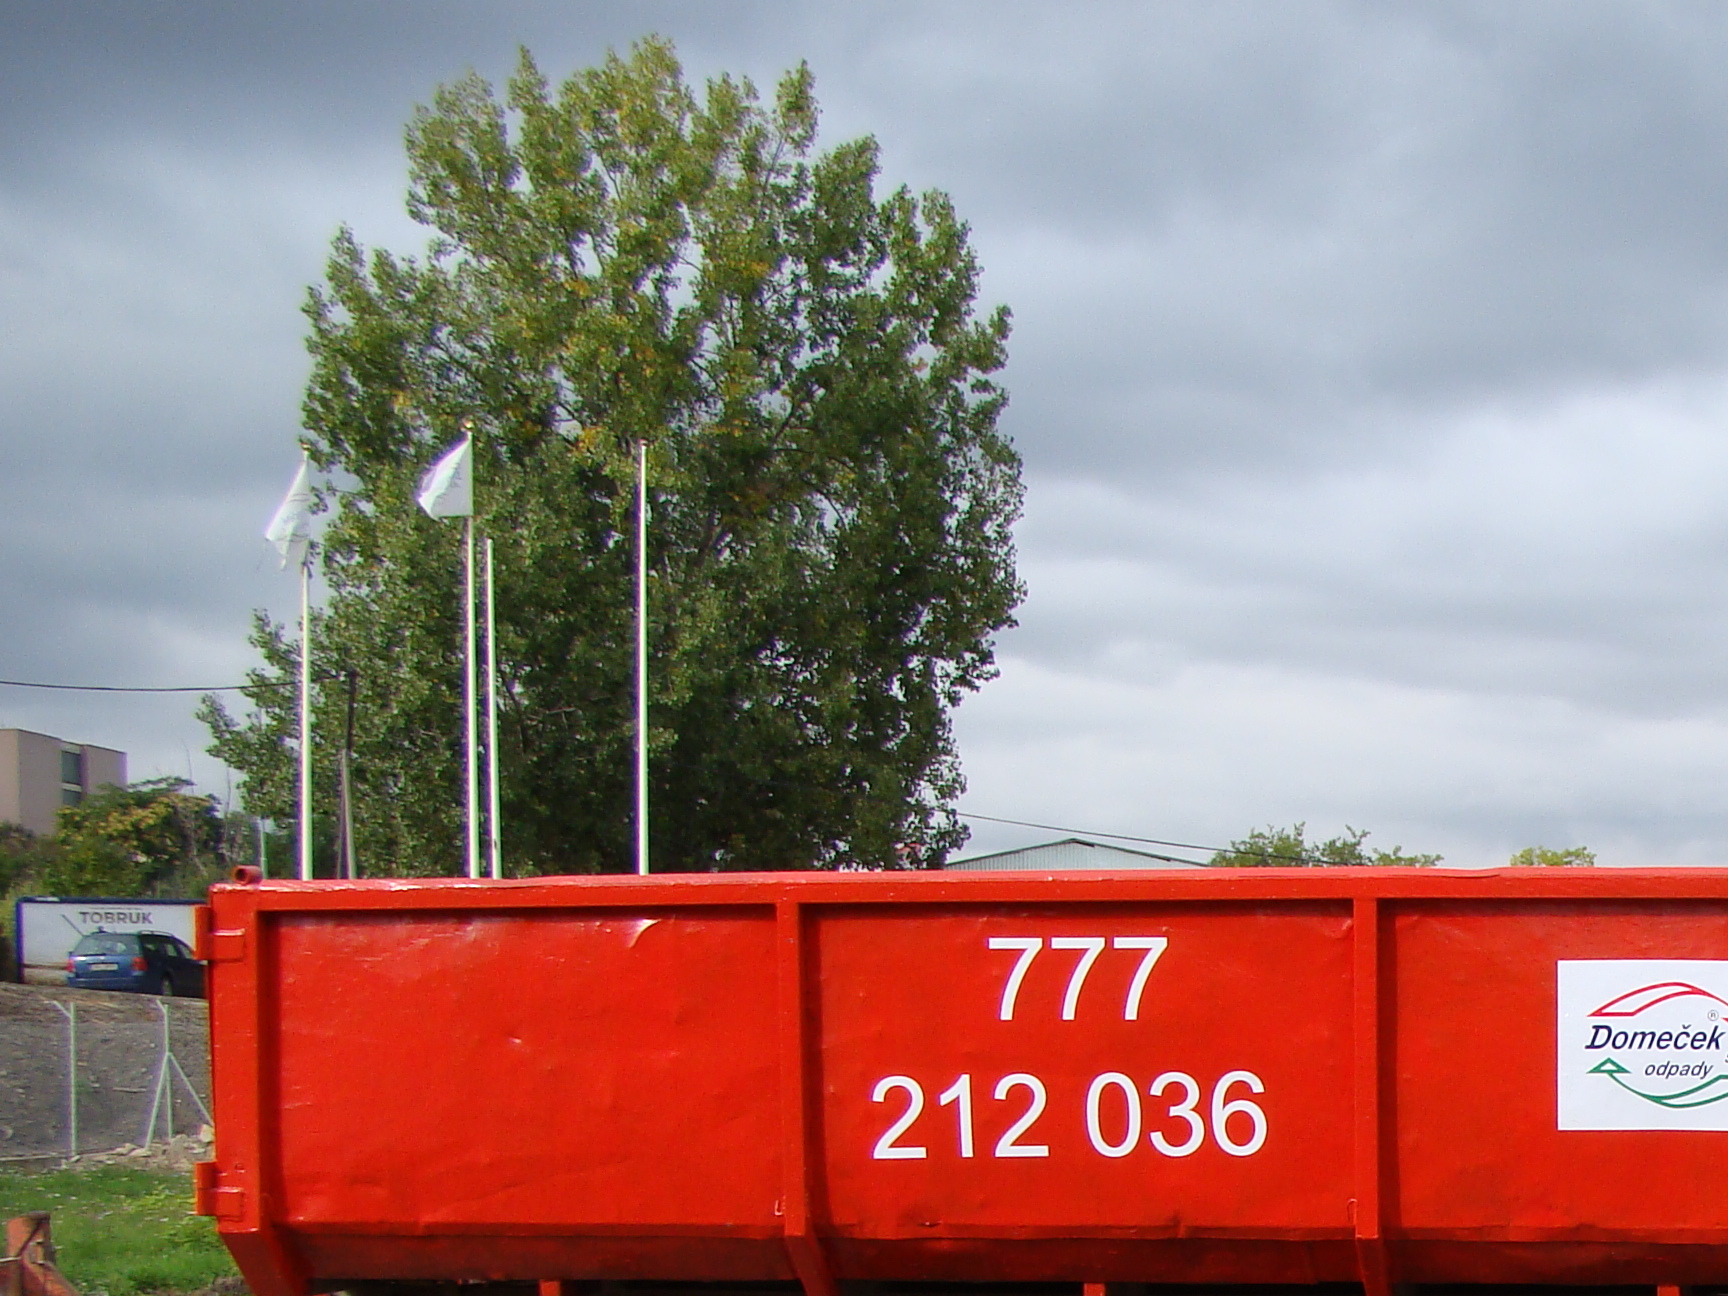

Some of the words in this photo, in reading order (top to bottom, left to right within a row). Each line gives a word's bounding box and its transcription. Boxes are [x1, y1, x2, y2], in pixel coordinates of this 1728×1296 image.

[79, 911, 154, 925] TOBRUK
[988, 936, 1168, 1021] 777
[1584, 1024, 1726, 1050] Domeček
[1644, 1060, 1714, 1080] odpady
[871, 1072, 1050, 1159] 212
[1085, 1070, 1268, 1158] 036
